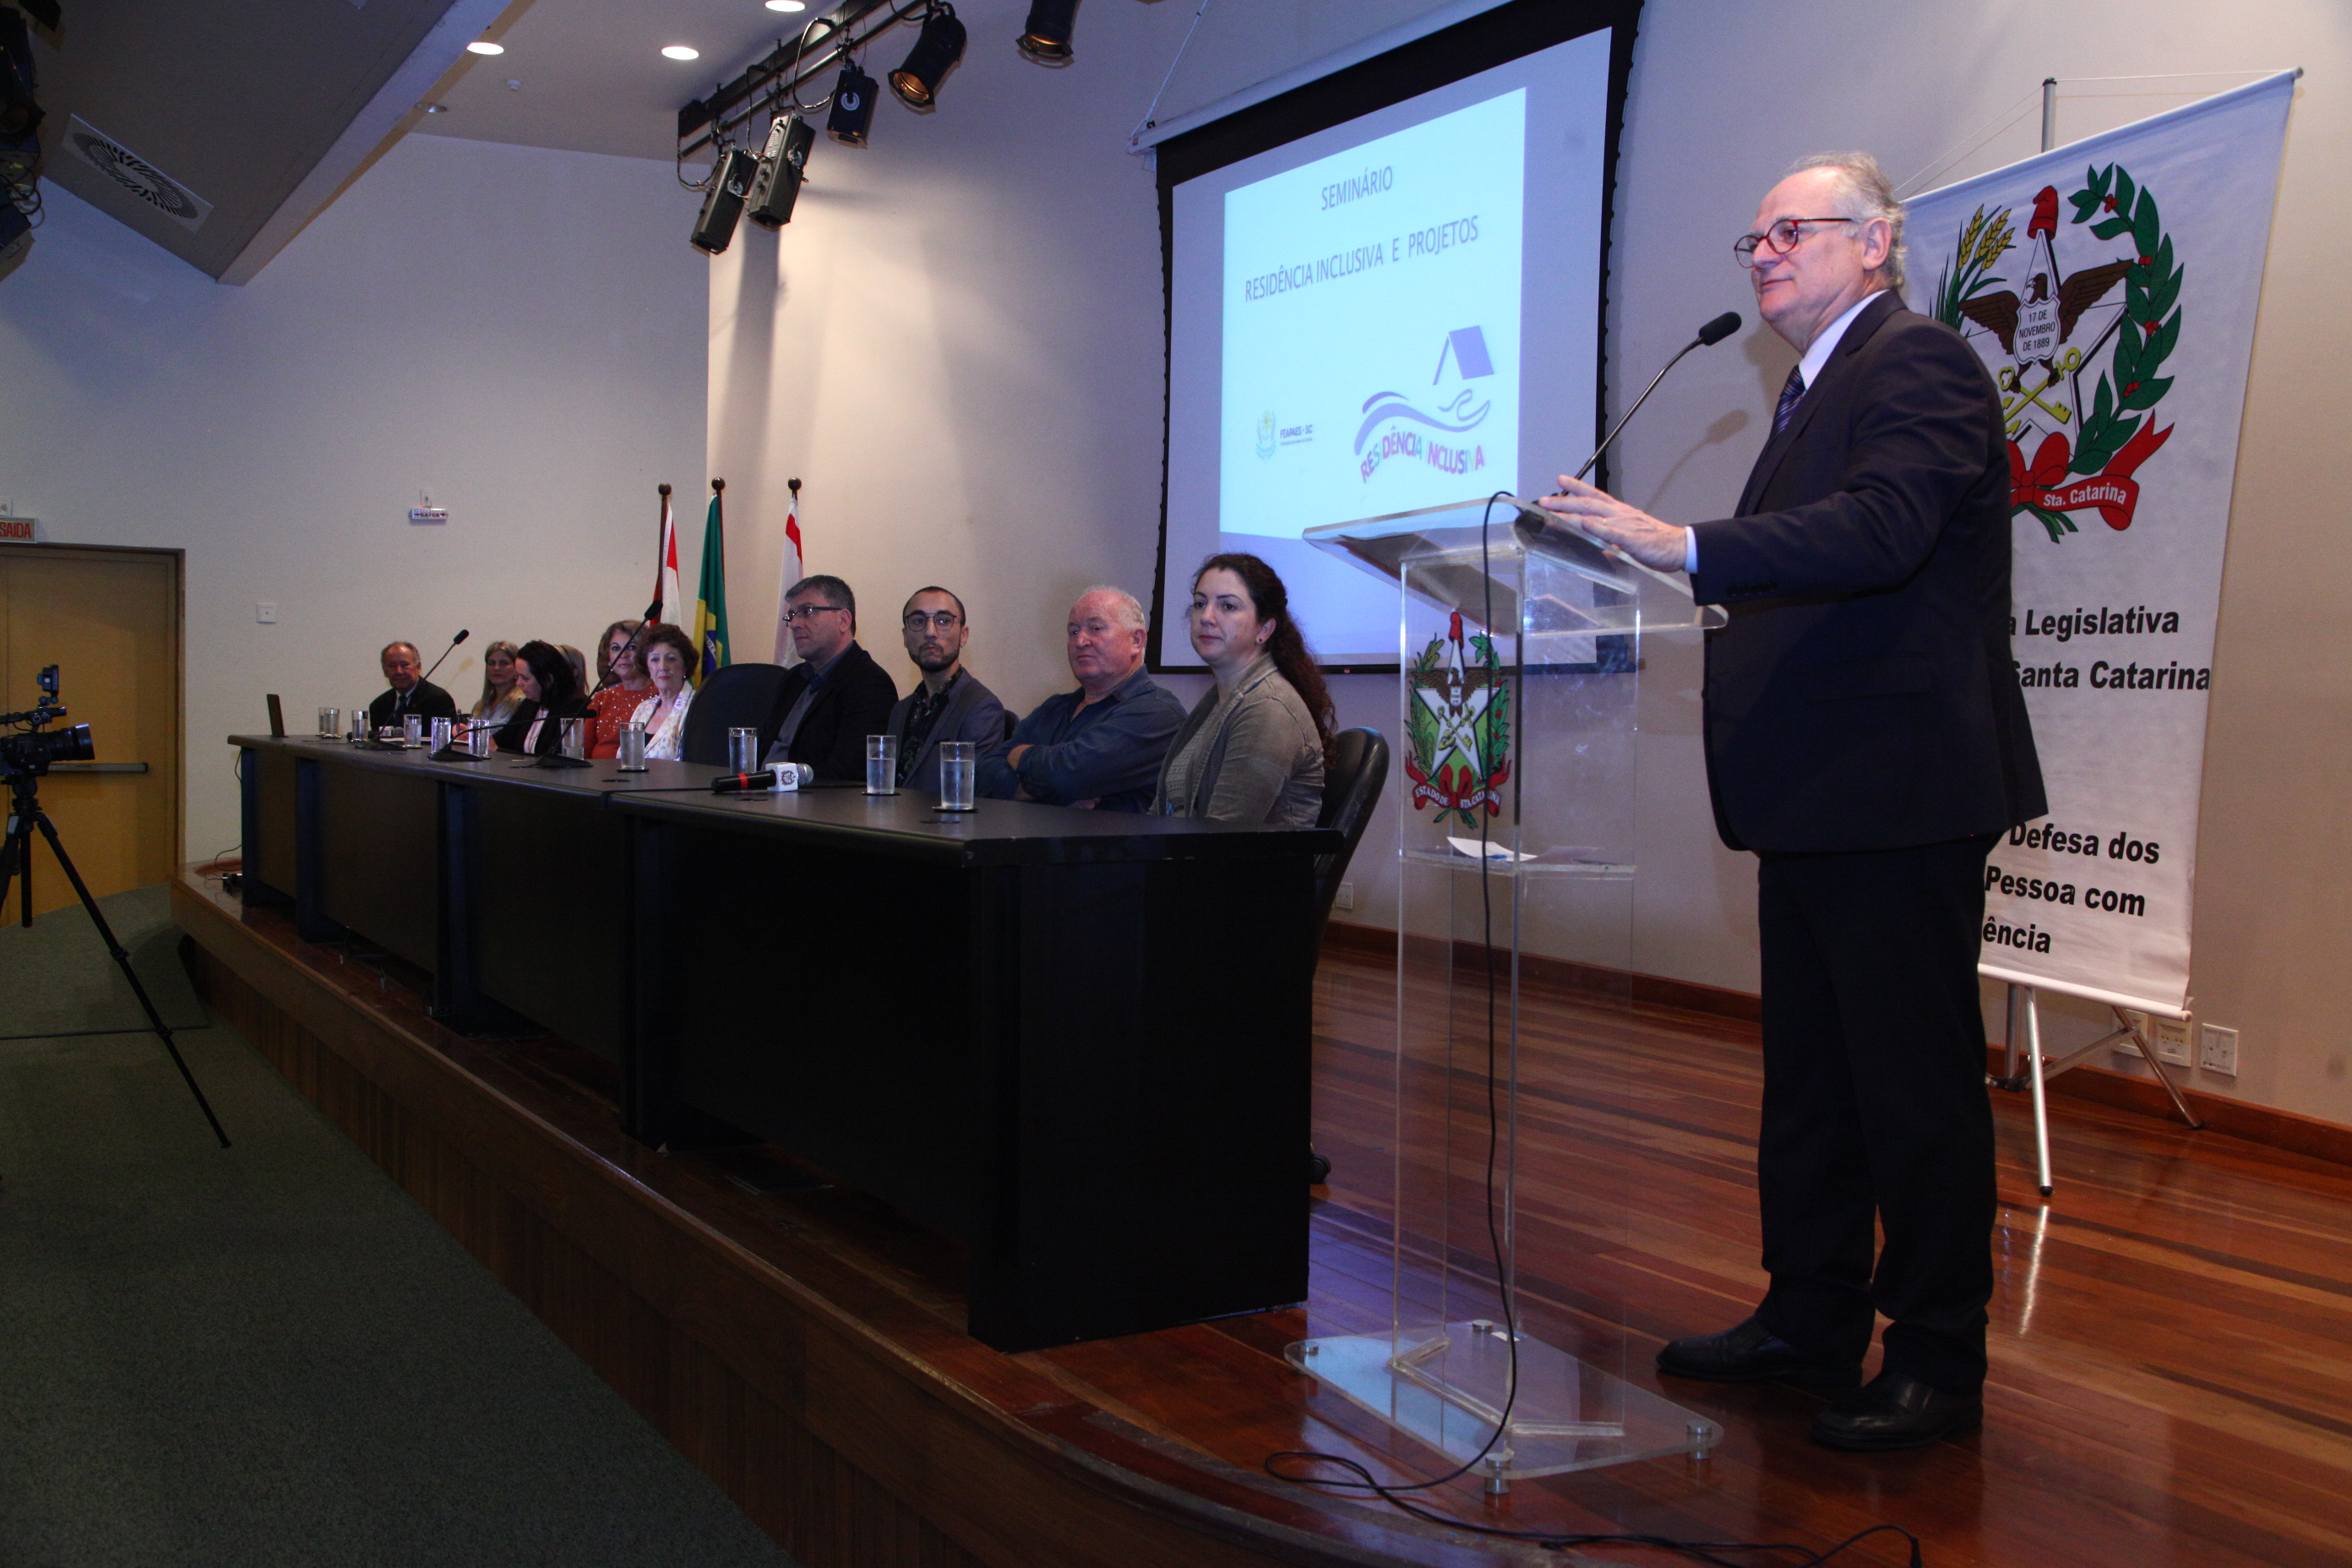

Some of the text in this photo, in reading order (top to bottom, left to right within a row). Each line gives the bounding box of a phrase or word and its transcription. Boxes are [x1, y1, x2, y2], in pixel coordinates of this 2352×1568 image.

[1320, 166, 1393, 211] SEMINÁRIO
[1245, 215, 1478, 302] RESIDÊNCIA INCLUSIVA E PROJETOS
[2019, 321, 2055, 338] NOVEMBRO
[2028, 309, 2047, 323] 17 DE
[2023, 337, 2050, 351] DE 1889
[1305, 424, 1313, 434] SC
[1360, 424, 1485, 484] RESIDÊNCIA INCLUSIVA
[2043, 482, 2127, 507] Sta. Catarina
[2025, 606, 2179, 642] Legislativa
[2089, 661, 2210, 689] Catarina
[1415, 786, 1449, 806] ESTADO DE
[2009, 822, 2160, 864] Defesa dos
[1985, 865, 2145, 917] Pessoa com
